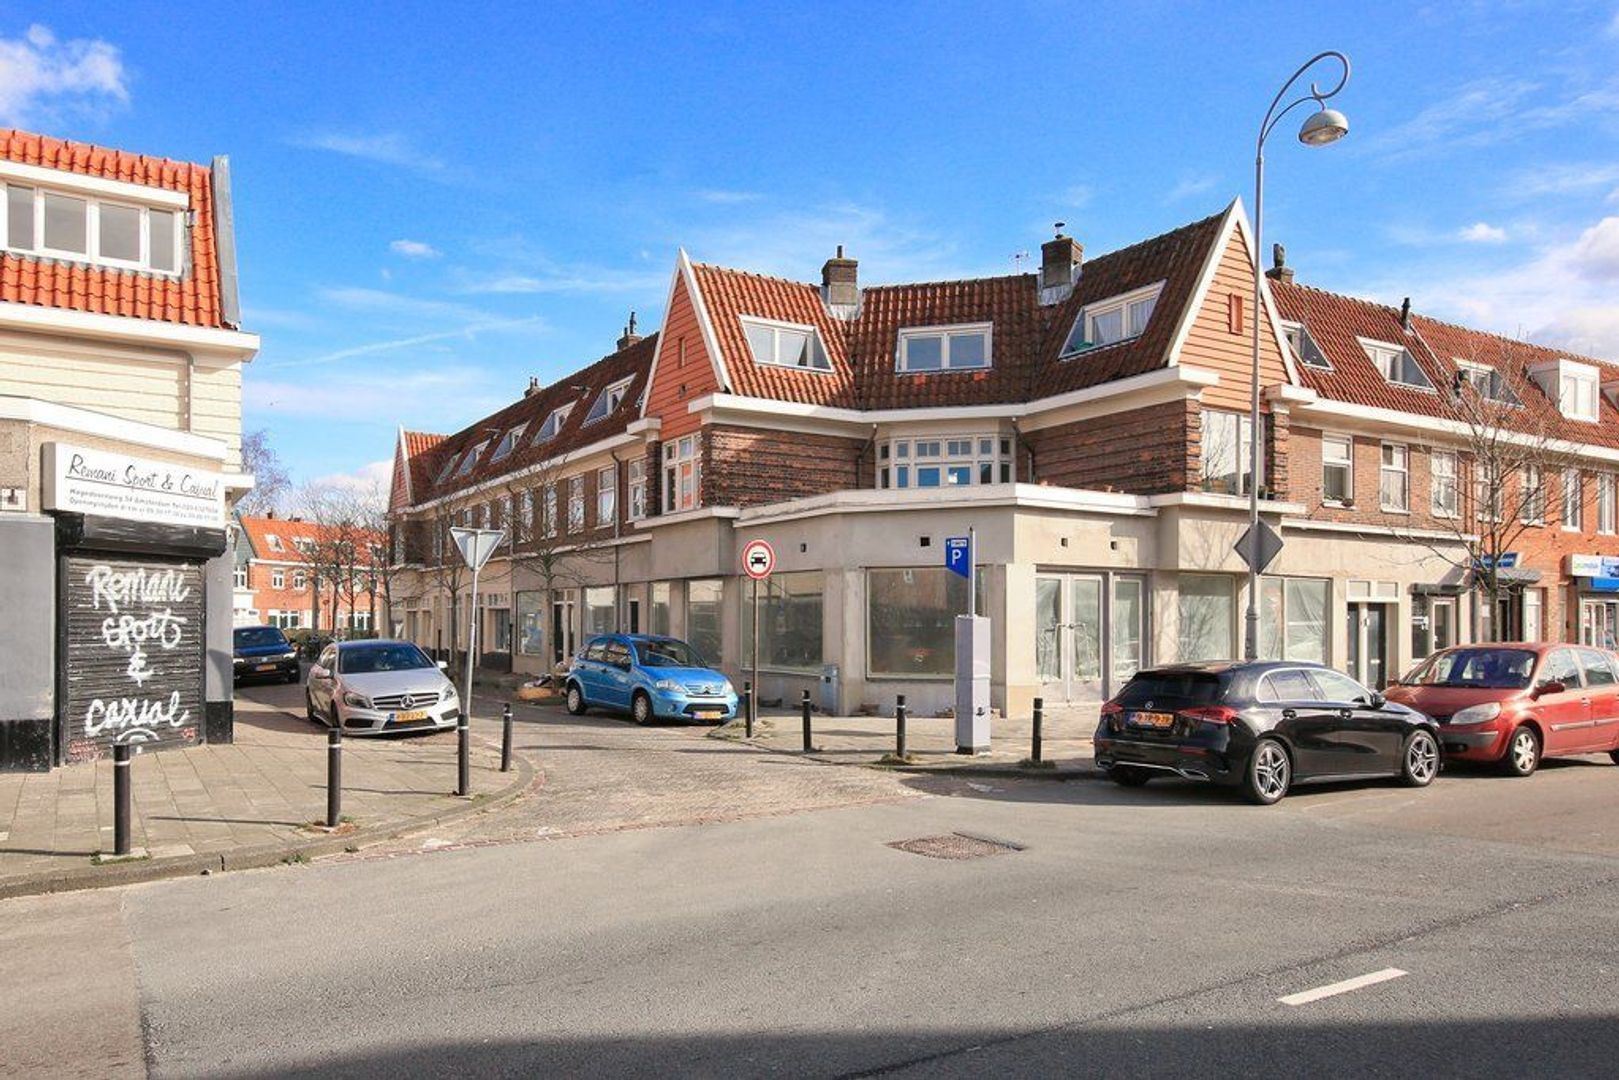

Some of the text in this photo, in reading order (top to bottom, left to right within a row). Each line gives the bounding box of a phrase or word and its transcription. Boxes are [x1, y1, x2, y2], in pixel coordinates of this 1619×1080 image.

[69, 453, 117, 482] Remani
[123, 464, 158, 493] Sport
[161, 473, 174, 490] &
[952, 549, 962, 565] P
